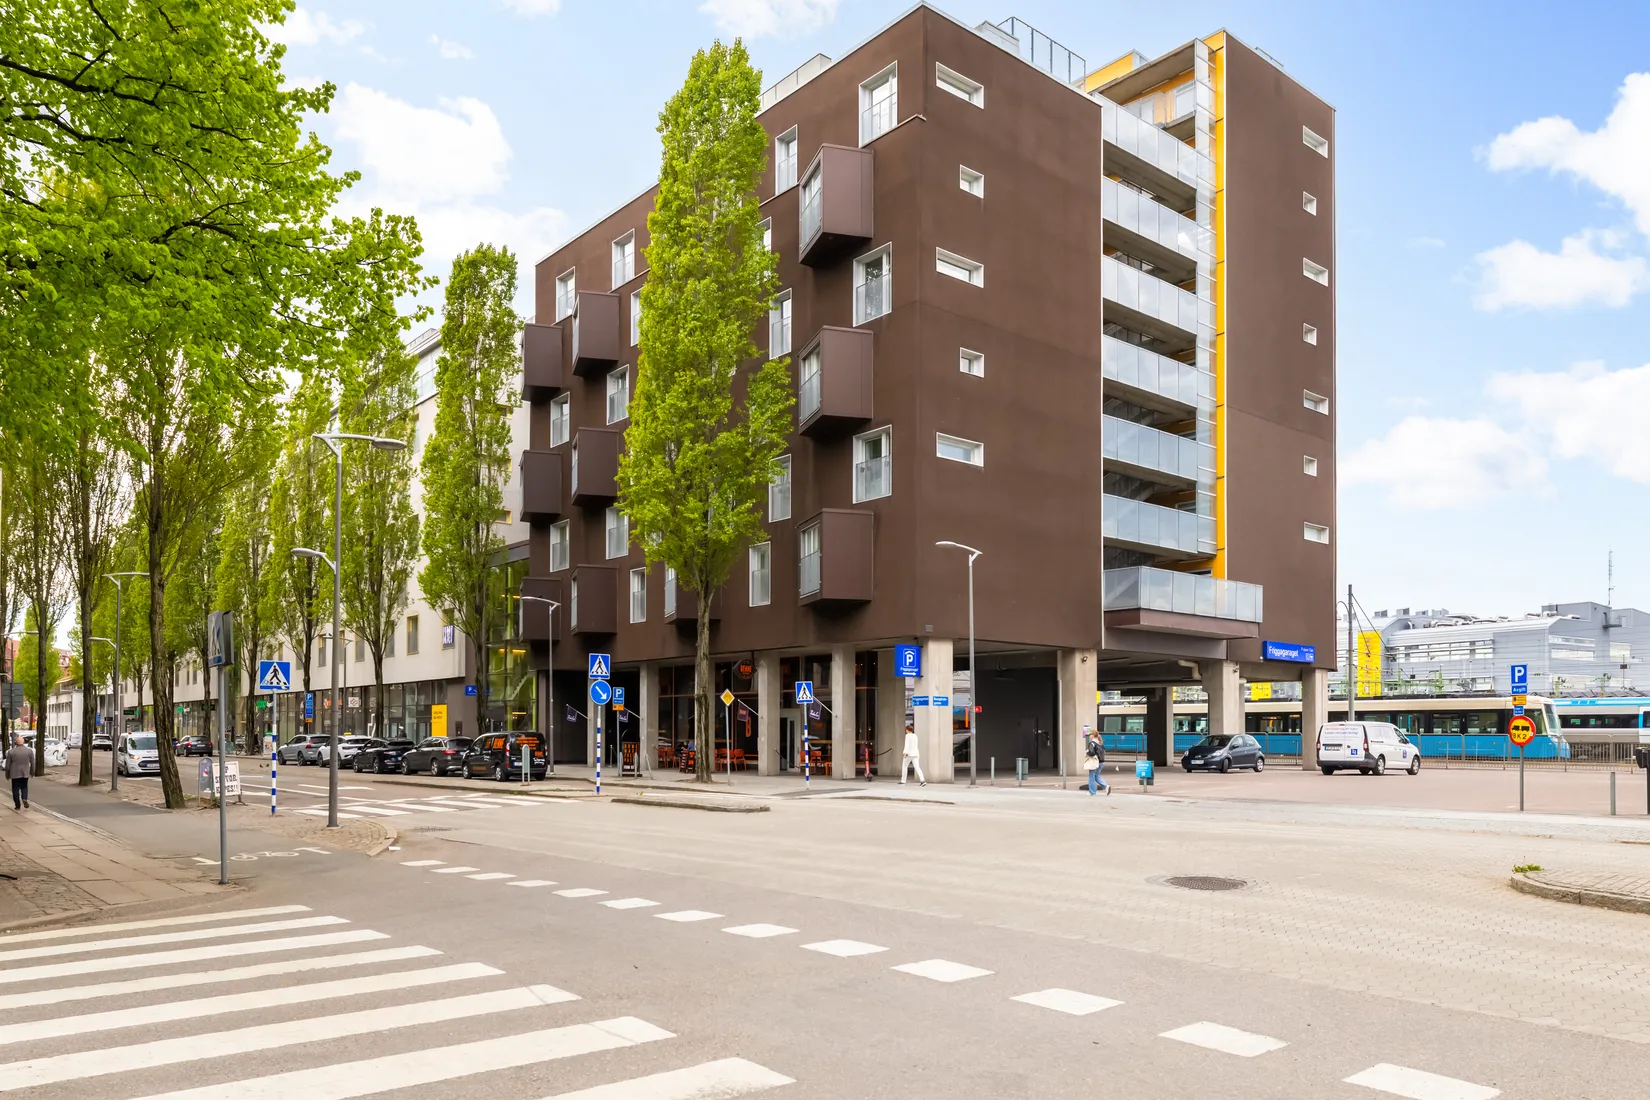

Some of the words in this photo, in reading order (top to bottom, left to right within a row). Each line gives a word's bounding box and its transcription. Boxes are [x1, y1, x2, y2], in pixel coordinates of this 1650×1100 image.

[1268, 645, 1299, 659] Friggagaraget
[906, 654, 914, 666] P
[1514, 666, 1525, 682] P
[615, 688, 622, 698] P
